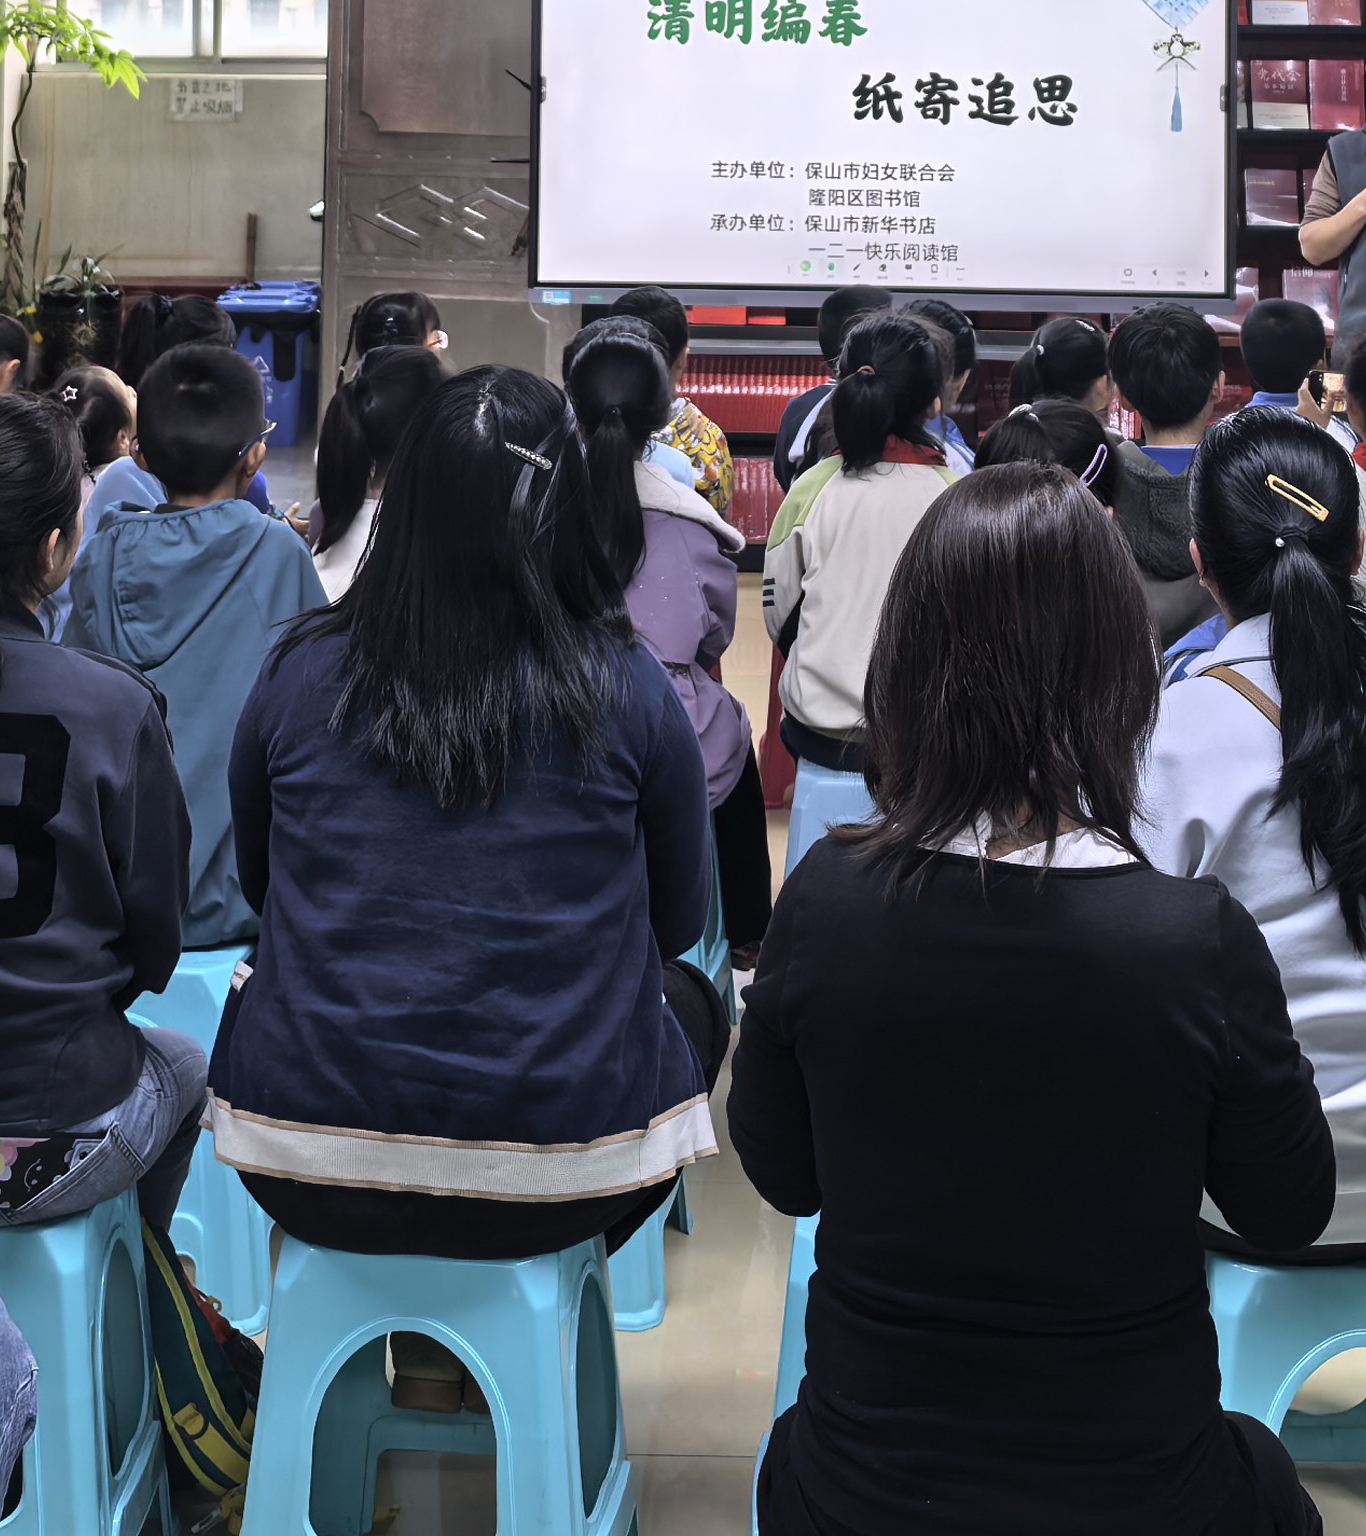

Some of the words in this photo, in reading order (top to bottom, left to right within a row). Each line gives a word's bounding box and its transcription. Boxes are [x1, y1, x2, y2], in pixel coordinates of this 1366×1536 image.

[851, 71, 1078, 127] 纸寄追思
[711, 160, 956, 182] 主办单位：保山市妇女联合会
[808, 188, 921, 208] 隆阳区图书馆
[709, 213, 936, 235] 承办单位：保山市新华书店
[807, 241, 959, 262] 一二一快乐阅读馆
